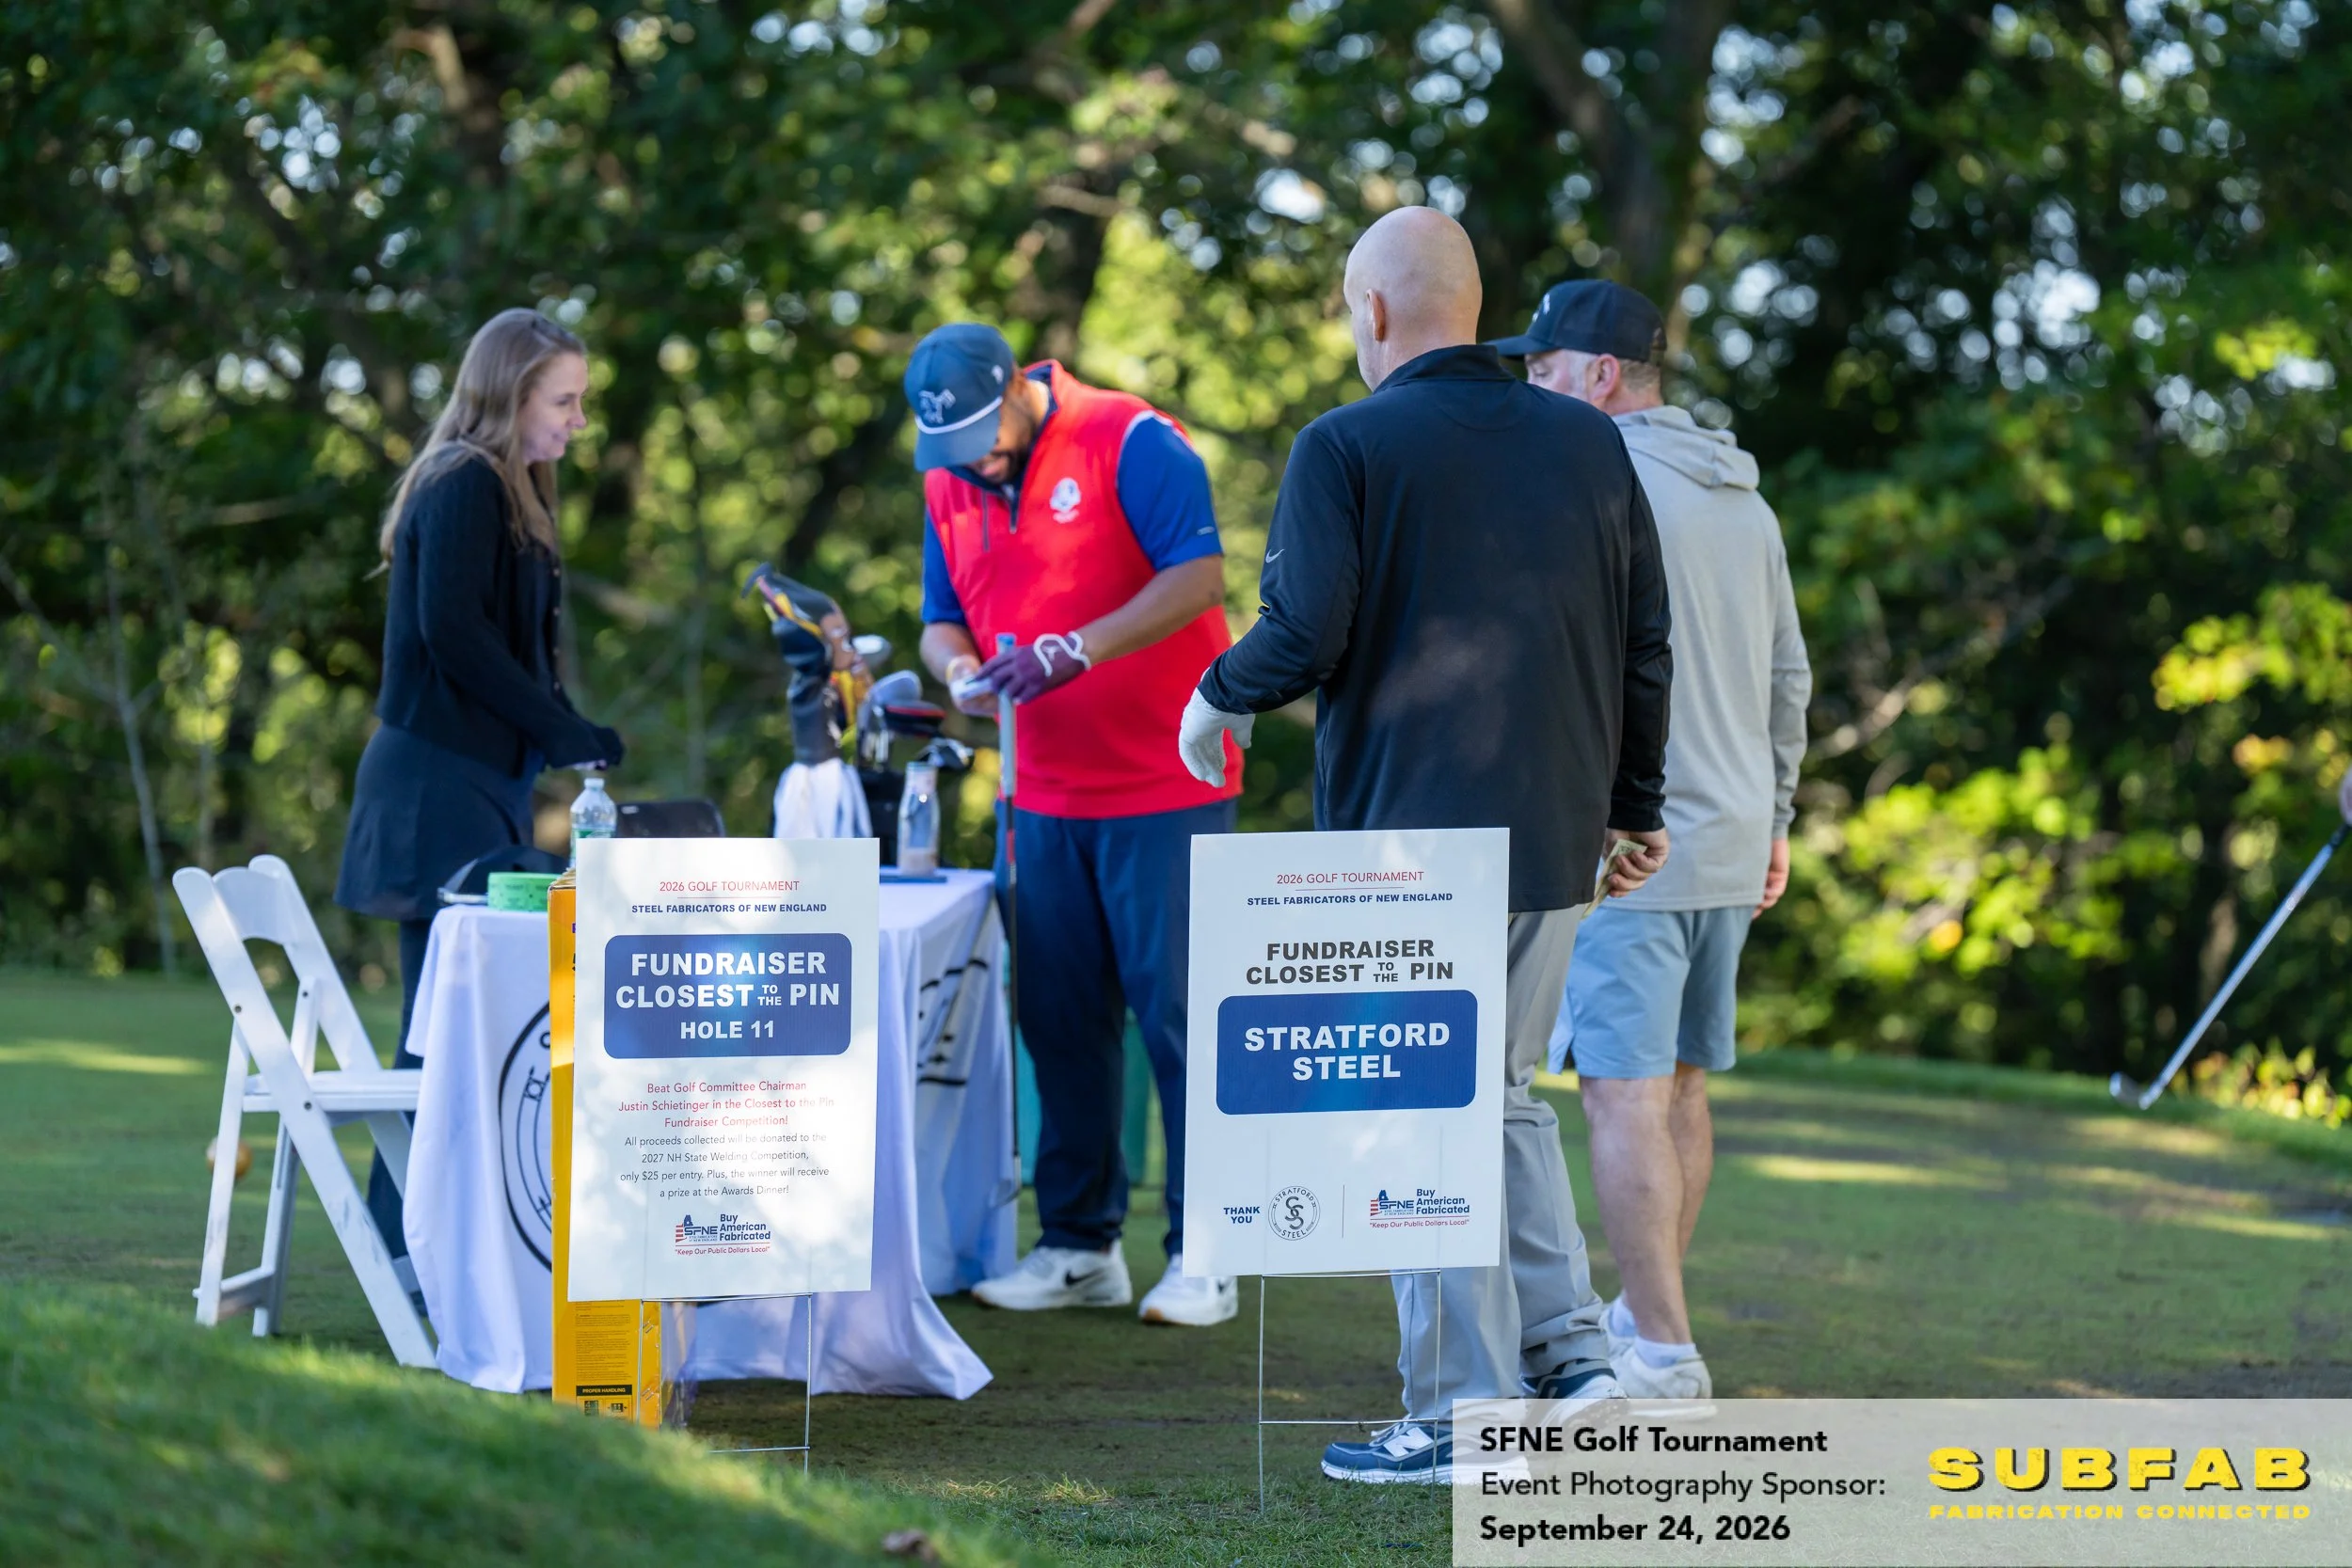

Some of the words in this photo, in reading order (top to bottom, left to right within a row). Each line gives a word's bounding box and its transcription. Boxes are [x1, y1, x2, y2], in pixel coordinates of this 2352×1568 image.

[1277, 874, 1303, 884] 2026
[1306, 873, 1338, 883] GOLF
[1342, 871, 1423, 883] TOURNAMENT
[660, 881, 684, 891] 2026
[688, 881, 717, 891] GOLF
[721, 880, 799, 891] TOURNAMENT
[1248, 897, 1280, 906] STEEL
[1283, 895, 1356, 905] FABRICATORS
[1359, 895, 1373, 903] OF
[1376, 894, 1400, 902] NEW
[1403, 893, 1453, 902] ENGLAND
[632, 905, 662, 913] STEEL
[666, 904, 735, 912] FABRICATORS
[1267, 940, 1434, 961] FUNDRAISER
[631, 952, 826, 975] FUNDRAISER
[1378, 962, 1394, 971] TO
[1247, 964, 1364, 985] CLOSEST
[1411, 962, 1454, 981] PIN
[1374, 973, 1398, 983] THE
[762, 985, 777, 994] TO
[790, 984, 839, 1006] PIN
[616, 984, 754, 1008] CLOSEST
[757, 996, 782, 1006] THE
[680, 1022, 742, 1038] HOLE
[751, 1021, 774, 1038] 11
[1245, 1022, 1451, 1052] STRATFORD
[1293, 1054, 1401, 1081] STEEL
[647, 1083, 670, 1093] Beat
[675, 1083, 695, 1092] Golf
[699, 1082, 755, 1092] Committee
[759, 1081, 806, 1091] Chairman
[619, 1101, 648, 1111] Justin
[652, 1101, 708, 1112] Schietinger
[713, 1100, 721, 1109] in
[725, 1100, 741, 1109] the
[745, 1098, 782, 1108] Closest
[786, 1099, 795, 1107] to
[800, 1098, 815, 1107] the
[664, 1117, 718, 1128] Fundraiser
[722, 1116, 788, 1128] Competition!
[625, 1137, 636, 1146] All
[640, 1136, 681, 1148] proceeds
[684, 1135, 724, 1145] collected
[727, 1134, 742, 1144] will
[760, 1133, 797, 1143] donated
[812, 1132, 827, 1142] the
[642, 1154, 663, 1163] 2027
[667, 1153, 681, 1163] NH
[685, 1152, 707, 1162] State
[710, 1152, 748, 1163] Welding
[751, 1150, 809, 1162] Competition,
[620, 1172, 639, 1182] only
[642, 1170, 659, 1180] $25
[662, 1173, 676, 1182] per
[679, 1172, 704, 1181] entry.
[707, 1169, 727, 1180] Plus,
[731, 1169, 744, 1178] the
[748, 1168, 778, 1177] winner
[780, 1167, 795, 1177] will
[798, 1167, 829, 1176] receive
[668, 1188, 690, 1199] prize
[704, 1187, 718, 1196] the
[721, 1186, 754, 1196] Awards
[756, 1185, 789, 1195] Dinner!
[1276, 1188, 1313, 1202] STRATFORD
[1417, 1189, 1435, 1198] Buy
[1379, 1200, 1414, 1210] SFNE
[1417, 1196, 1465, 1205] American
[1416, 1205, 1470, 1214] Fabricated
[721, 1214, 738, 1224] Buy
[685, 1226, 718, 1235] SFNE
[720, 1222, 766, 1231] American
[720, 1231, 771, 1241] Fabricated
[1281, 1229, 1306, 1238] STEEL
